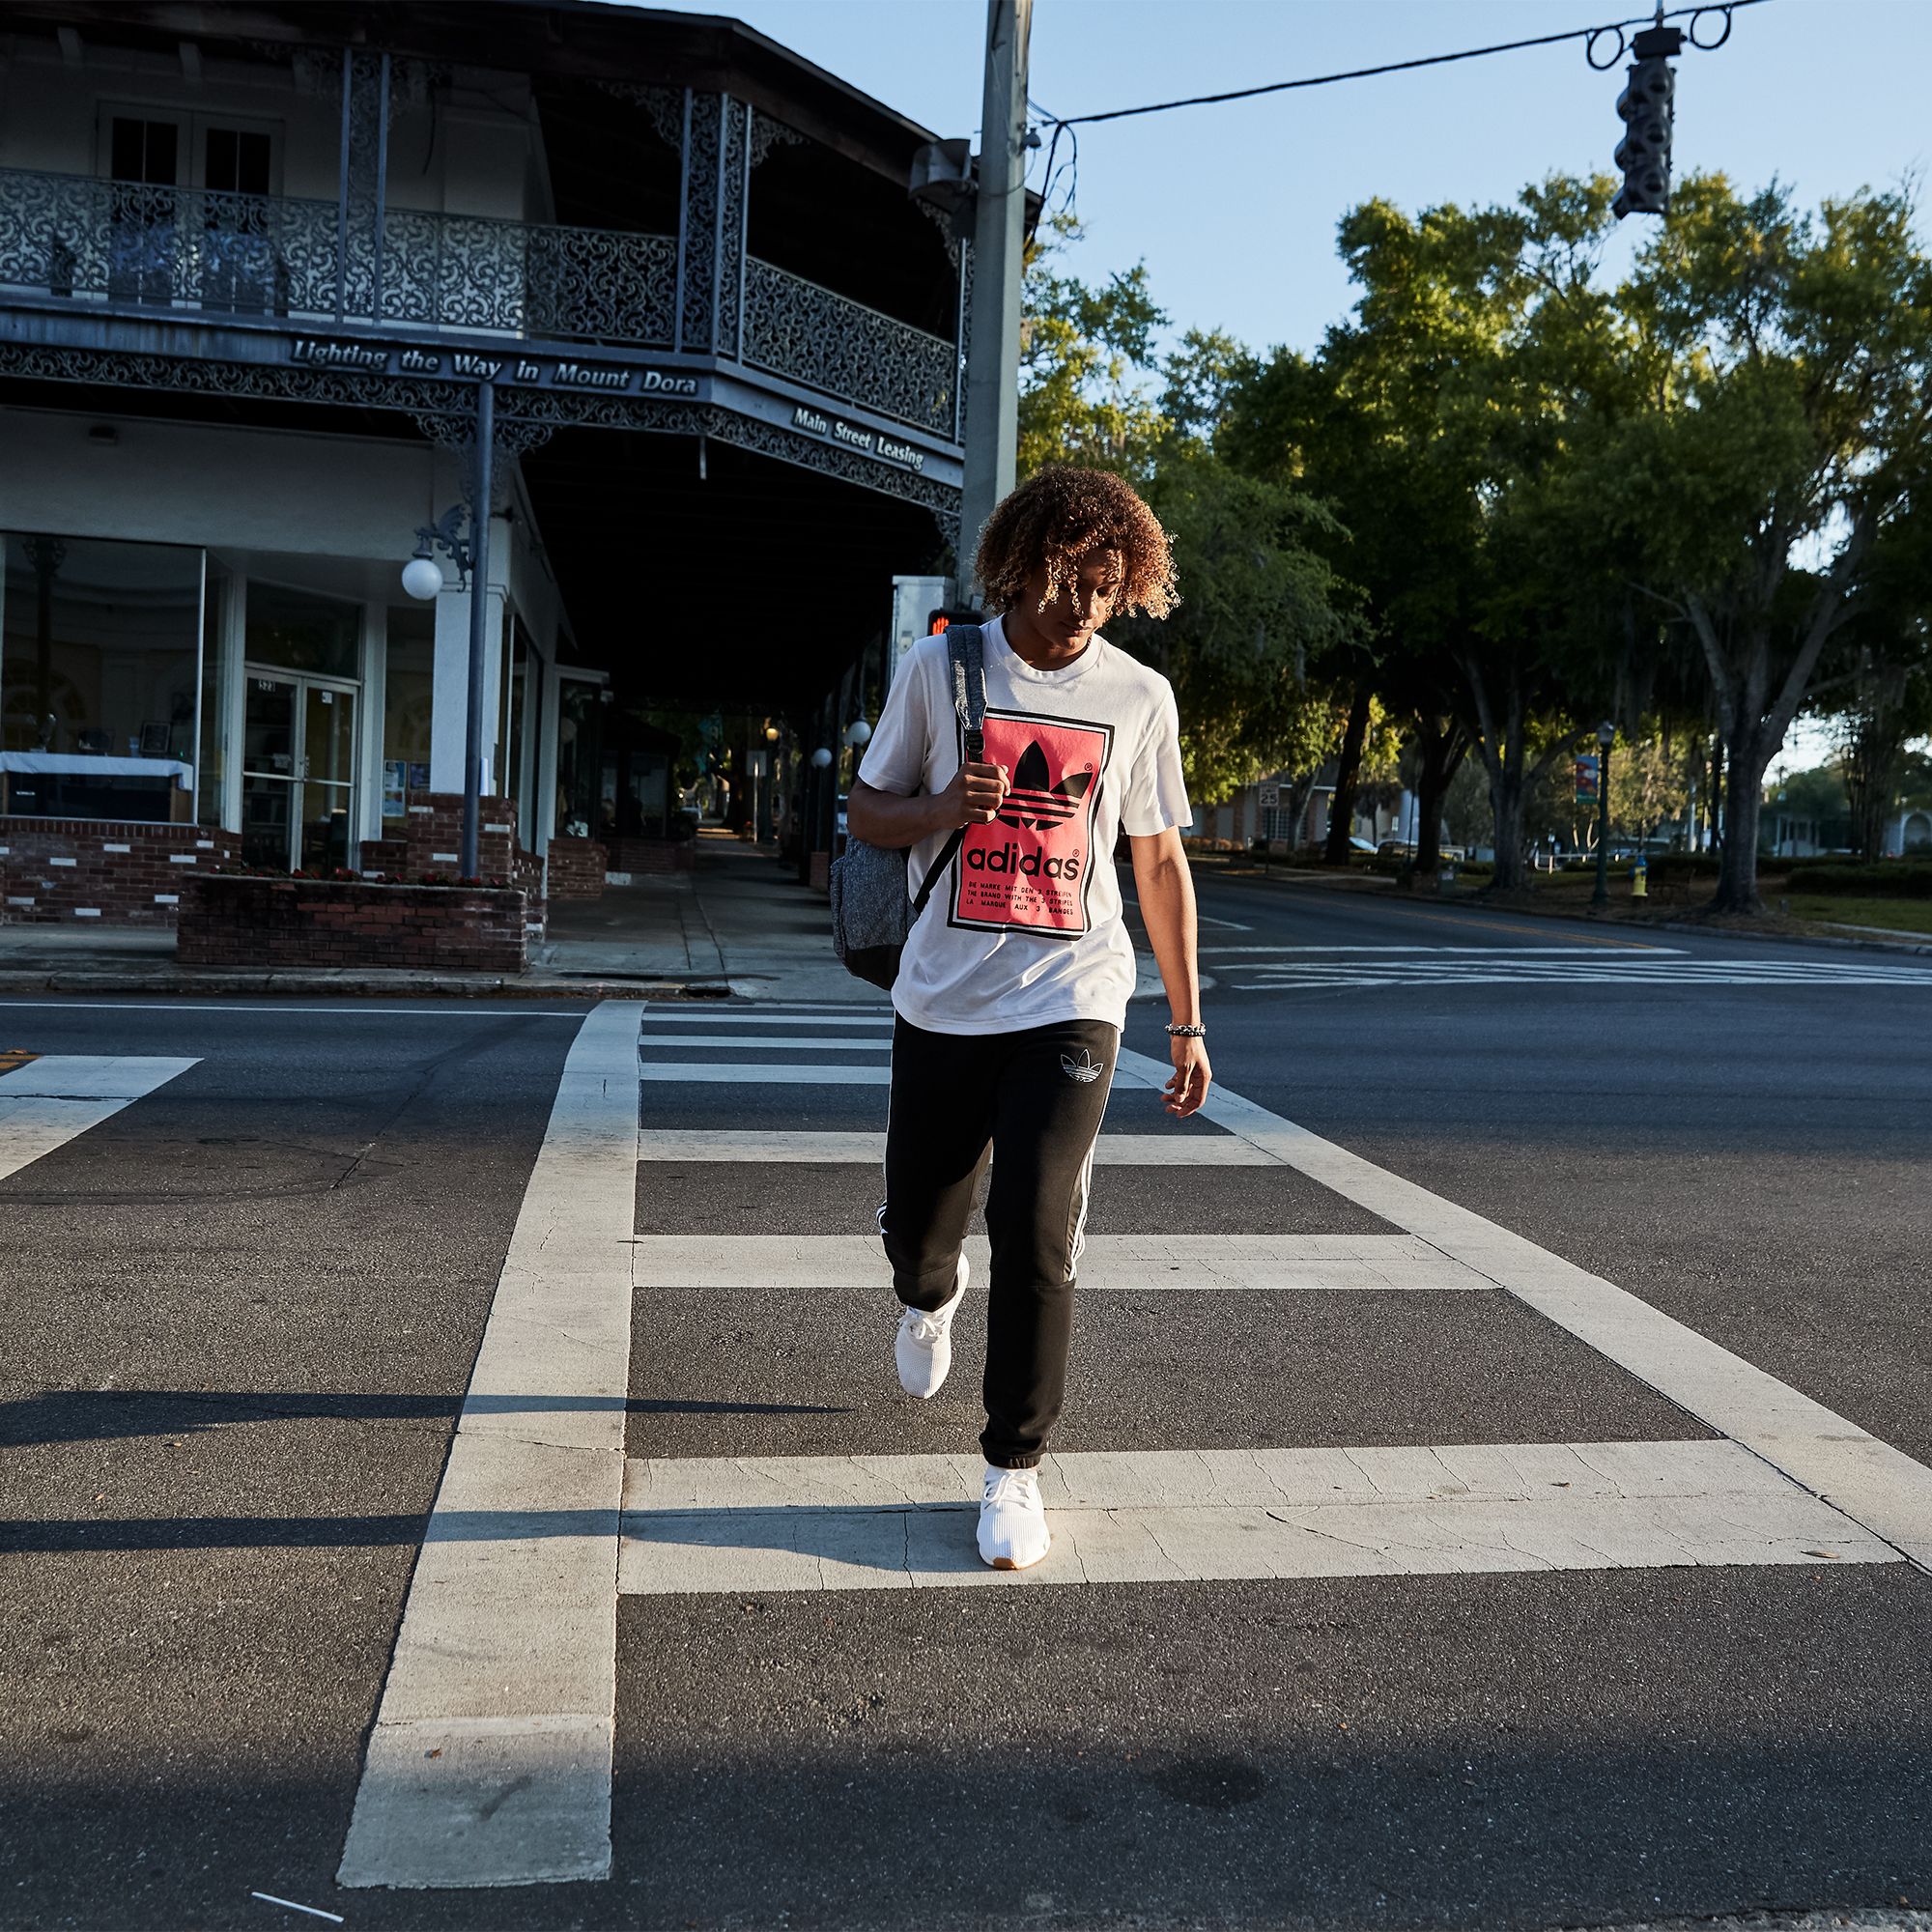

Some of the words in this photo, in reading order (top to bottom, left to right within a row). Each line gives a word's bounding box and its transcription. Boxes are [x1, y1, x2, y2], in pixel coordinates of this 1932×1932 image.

[293, 340, 387, 370] Lighting
[401, 350, 439, 371] the
[453, 354, 501, 381] Way
[516, 360, 539, 380] in
[554, 363, 630, 387] Mount
[642, 371, 696, 393] Dora
[794, 408, 827, 434] Main
[835, 421, 871, 449] Street
[877, 437, 924, 470] Leasing
[1261, 793, 1277, 804] 25
[967, 842, 1079, 881] adidas
[980, 882, 1001, 891] MARKE
[980, 891, 1001, 899] BRAND
